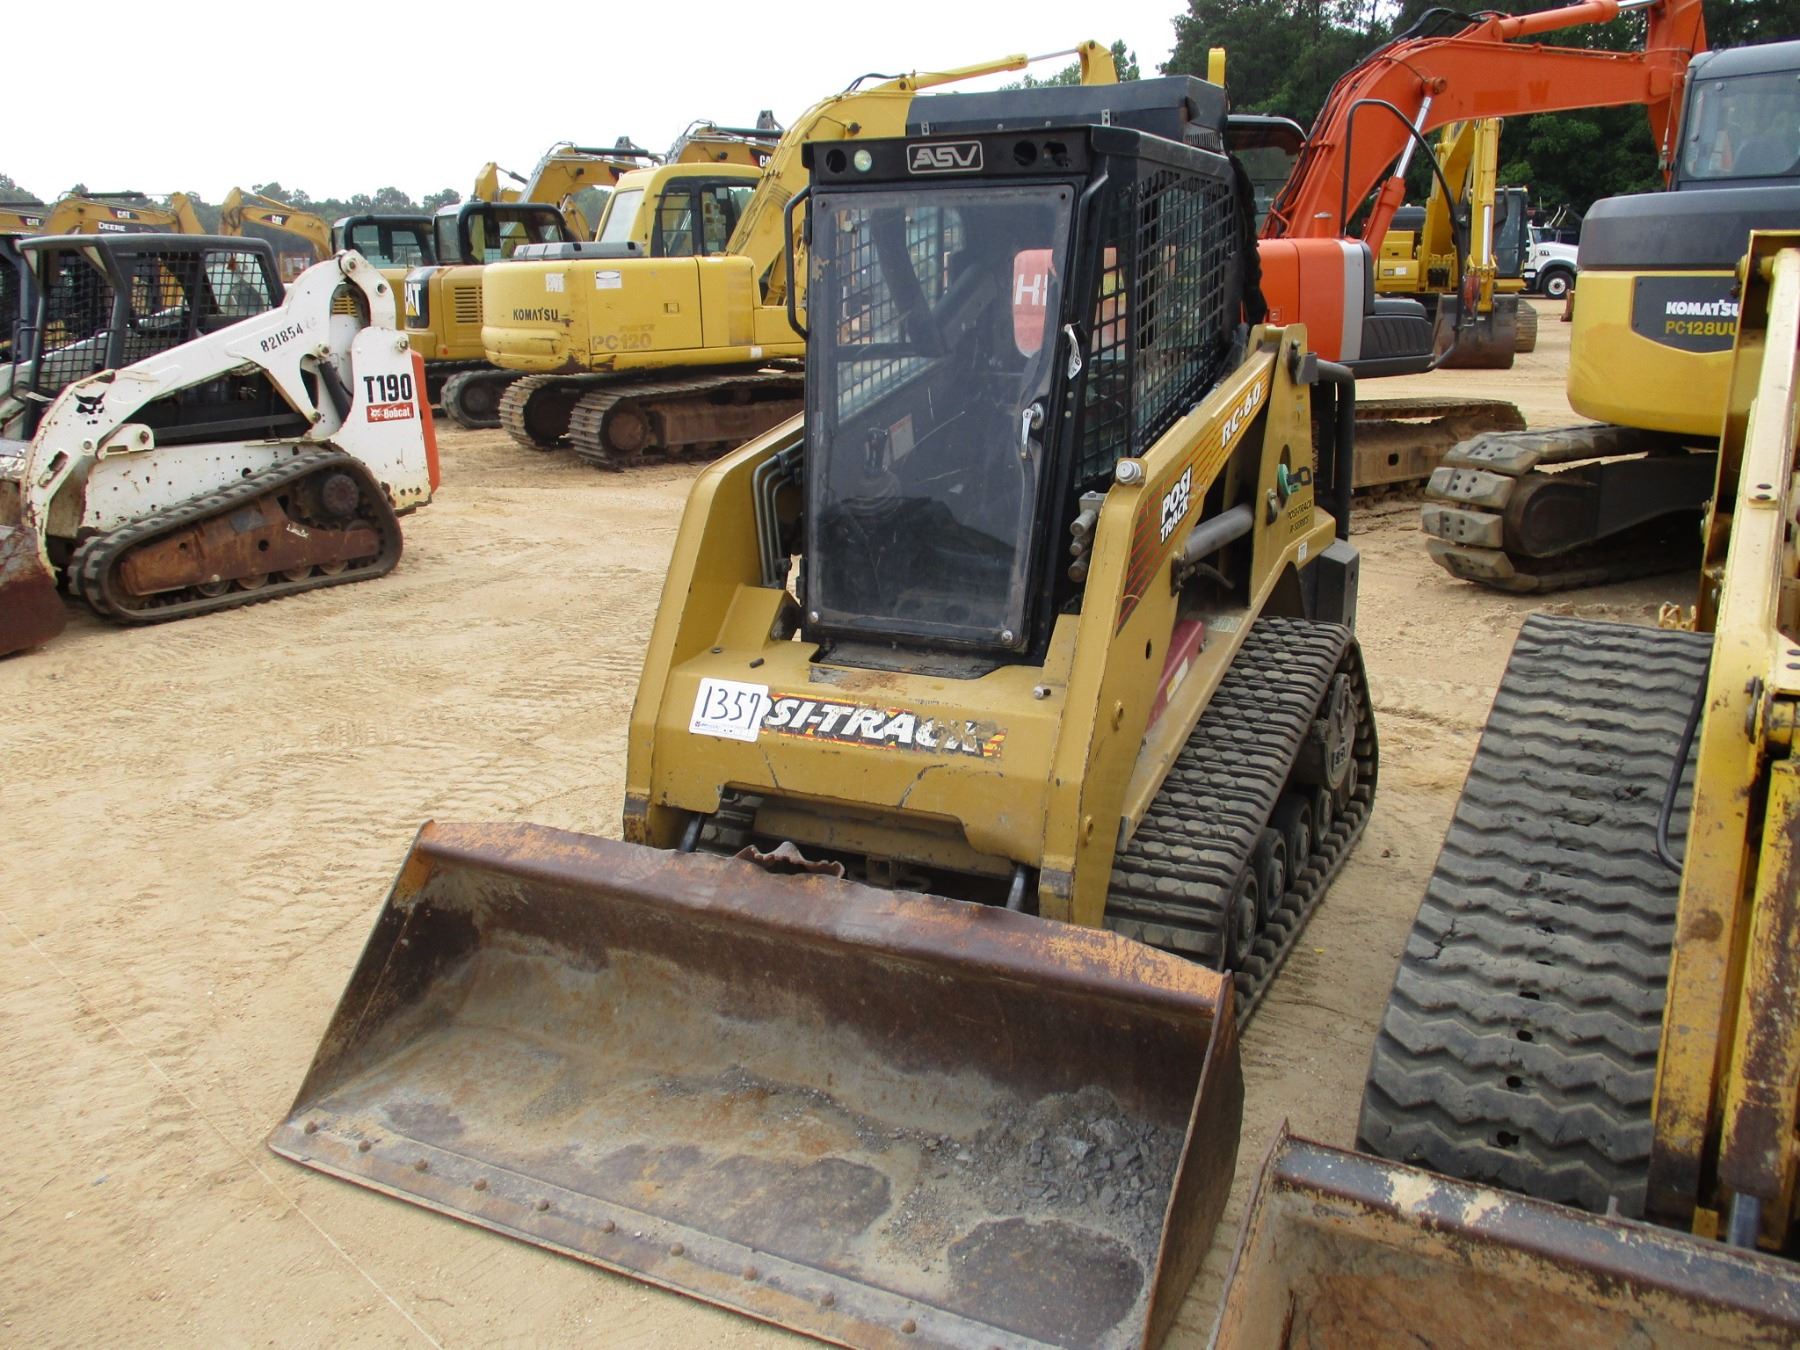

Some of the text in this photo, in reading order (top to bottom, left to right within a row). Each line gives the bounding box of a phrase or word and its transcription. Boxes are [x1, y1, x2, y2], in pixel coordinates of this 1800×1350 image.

[911, 145, 978, 169] ASV
[98, 221, 126, 232] DEERE
[513, 307, 559, 321] KOMATSU
[260, 323, 304, 353] 821854
[591, 333, 651, 351] PC120
[363, 373, 413, 403] T190
[383, 406, 411, 419] Bobcat
[1161, 464, 1193, 524] POSI
[1160, 494, 1189, 543] TRACK
[701, 686, 761, 730] 1357
